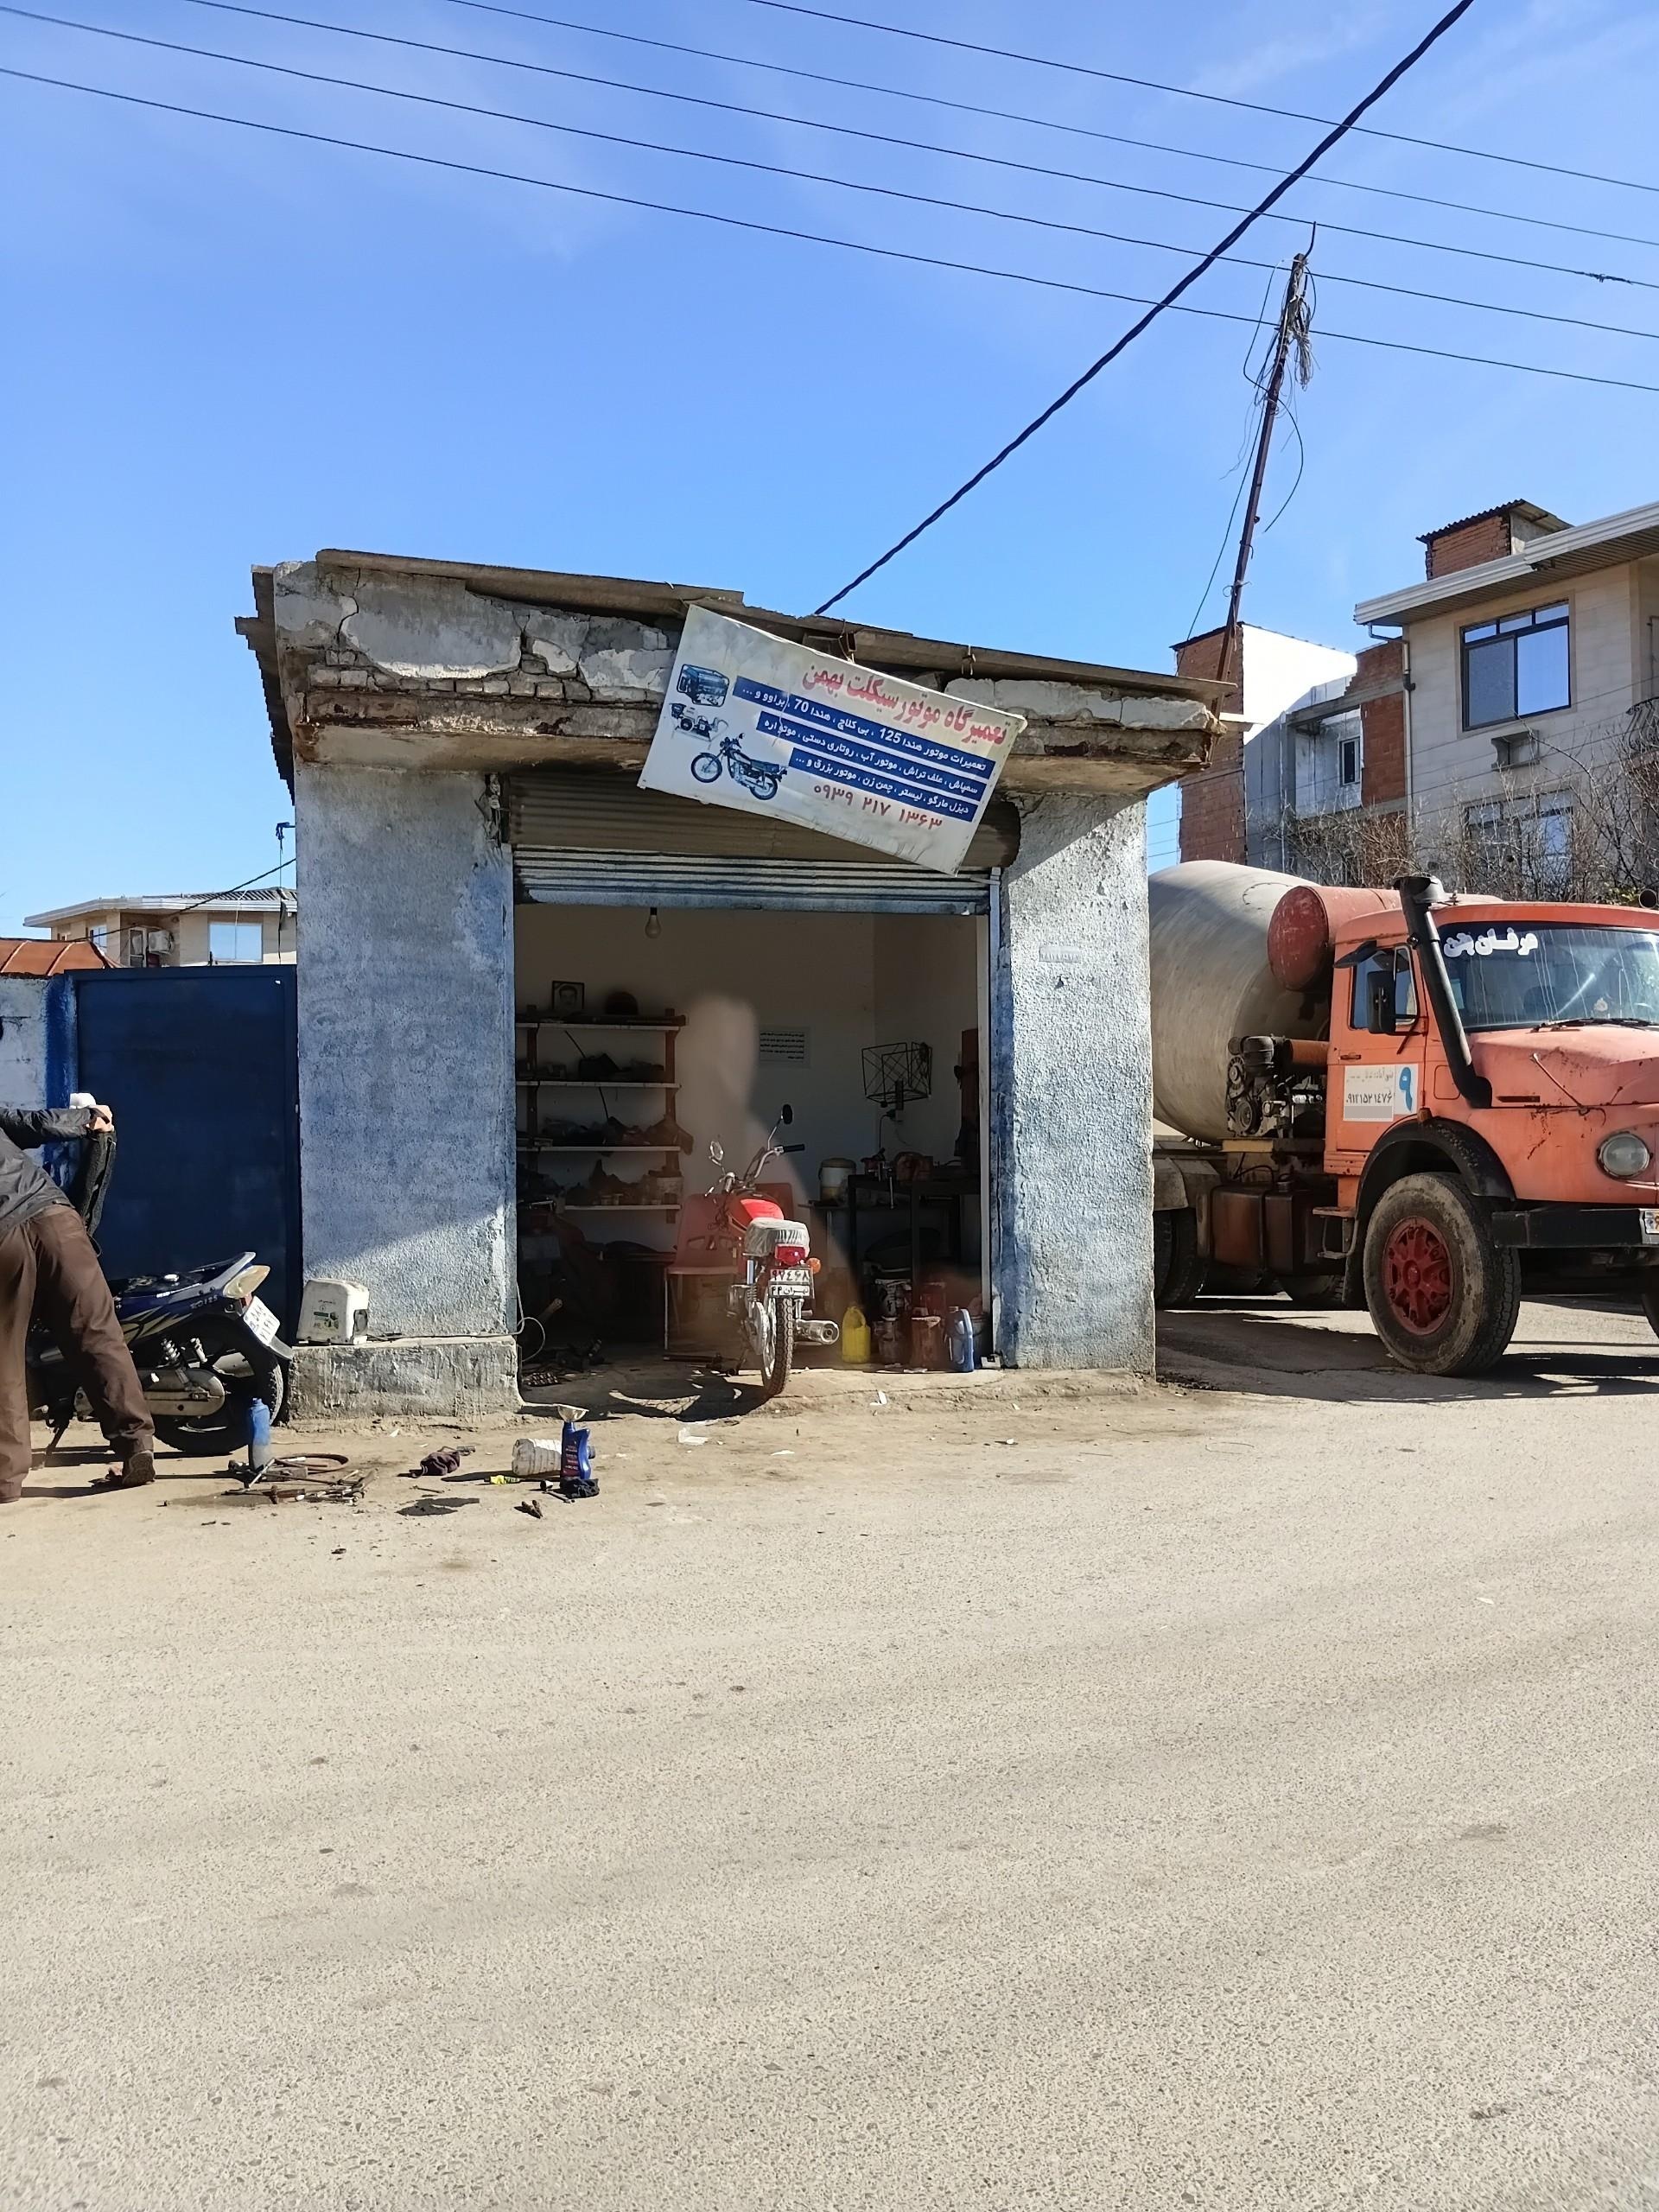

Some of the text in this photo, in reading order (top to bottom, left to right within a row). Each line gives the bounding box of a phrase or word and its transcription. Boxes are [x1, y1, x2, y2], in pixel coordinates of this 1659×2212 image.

[754, 690, 761, 699] و
[793, 698, 810, 713] 70
[802, 664, 1009, 745] تعمیرگاه موتور سیکلت بهمن
[810, 707, 831, 721] هندا
[764, 719, 777, 730] اره
[836, 718, 858, 731] کلاچ
[857, 727, 870, 736] بی
[879, 728, 902, 744] 125
[802, 734, 826, 746] دستی
[902, 737, 923, 752] هندا
[827, 741, 855, 758] روتاری
[923, 749, 949, 760] موتور
[806, 758, 812, 766] و
[860, 753, 875, 762] آب
[874, 758, 898, 770] موتور
[950, 754, 987, 772] تعمیرات
[834, 767, 857, 780] موتور
[903, 766, 926, 779] تراش
[927, 772, 943, 785] علف
[862, 777, 875, 787] زن
[875, 780, 893, 793] چمن
[949, 780, 978, 794] سمپاش
[898, 788, 923, 802] لیستر
[927, 795, 949, 808] مارگو
[814, 785, 943, 830] ۰۹۳۹ ۲۱۷ ۱۳۶۳
[949, 801, 969, 814] دیزل
[1475, 927, 1538, 955] عرفان
[784, 1287, 809, 1295] تهران
